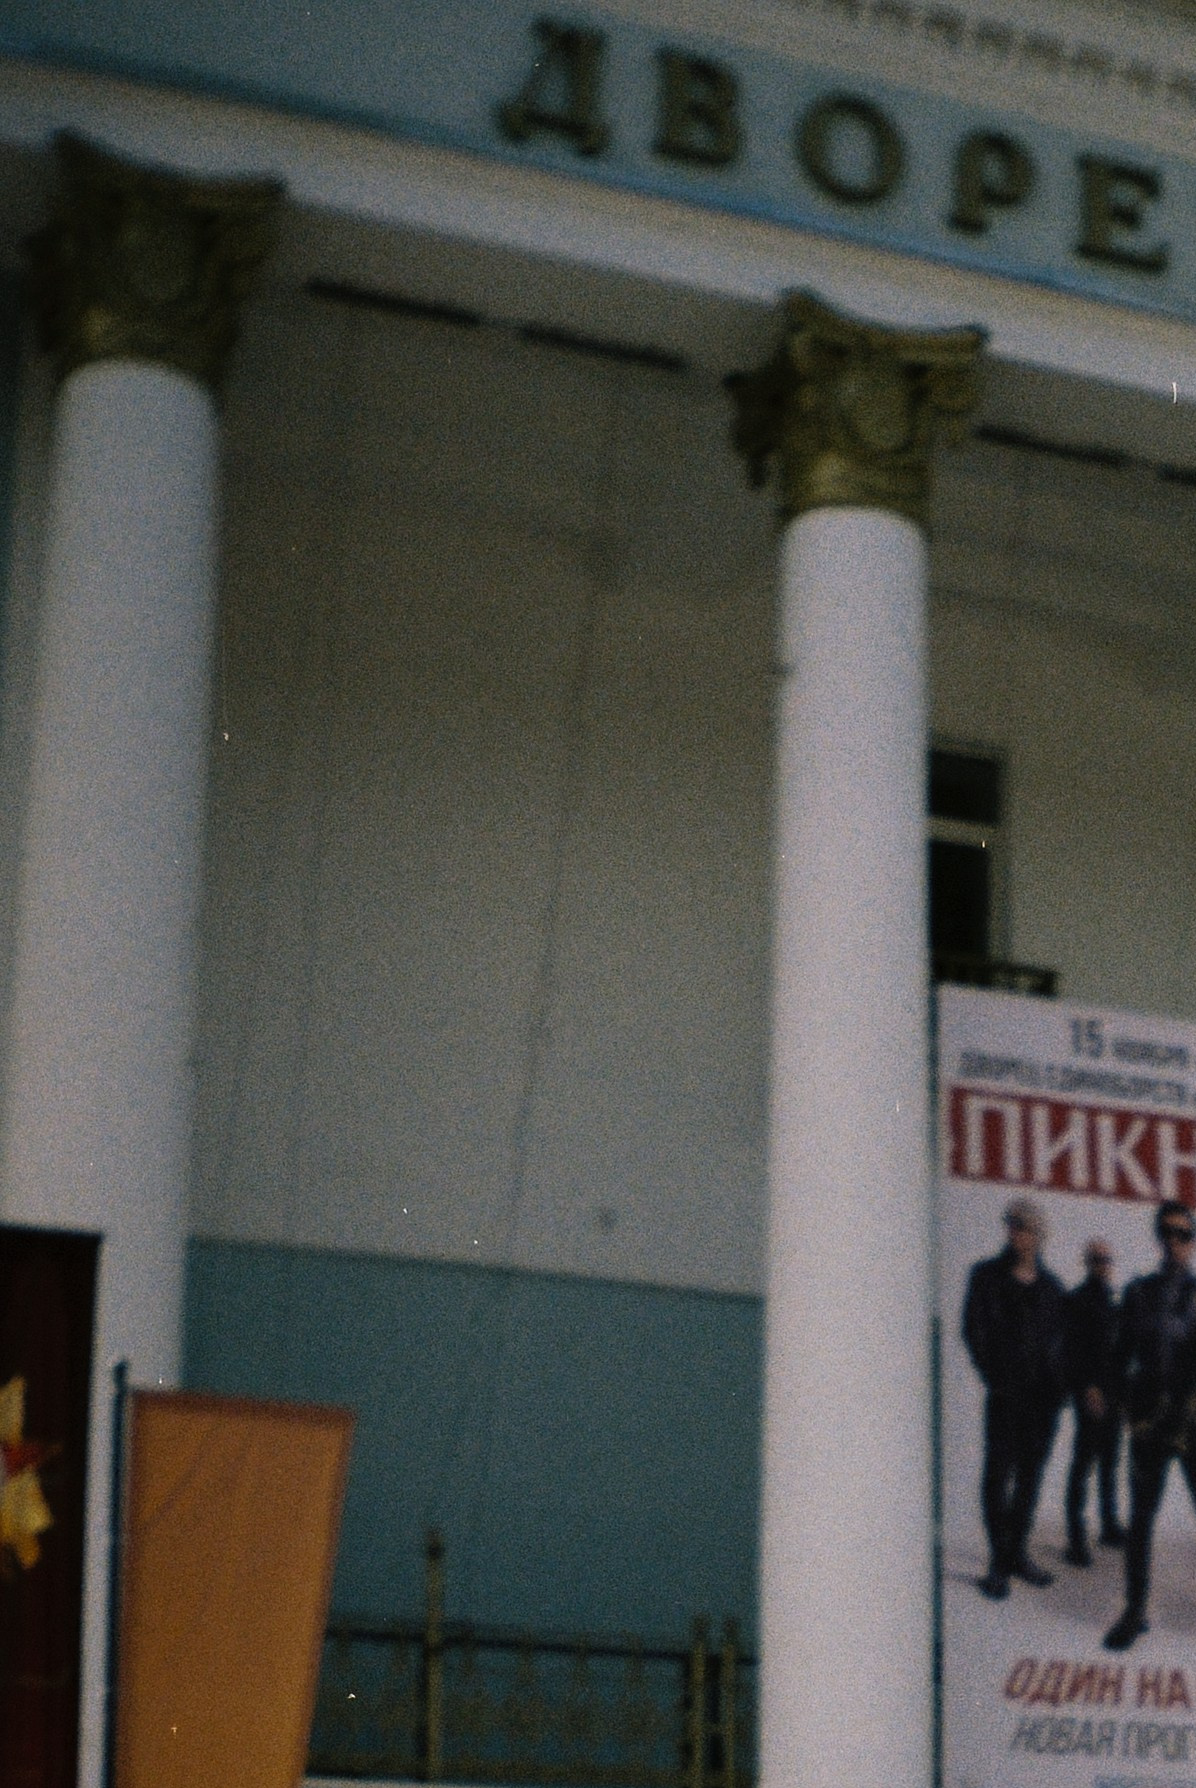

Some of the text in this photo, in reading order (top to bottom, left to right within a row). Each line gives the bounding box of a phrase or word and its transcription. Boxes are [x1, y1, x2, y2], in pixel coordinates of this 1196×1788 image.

[1004, 1657, 1125, 1706] ОДИН
[1136, 1664, 1192, 1709] НА
[1010, 1716, 1115, 1756] НОВАЯ
